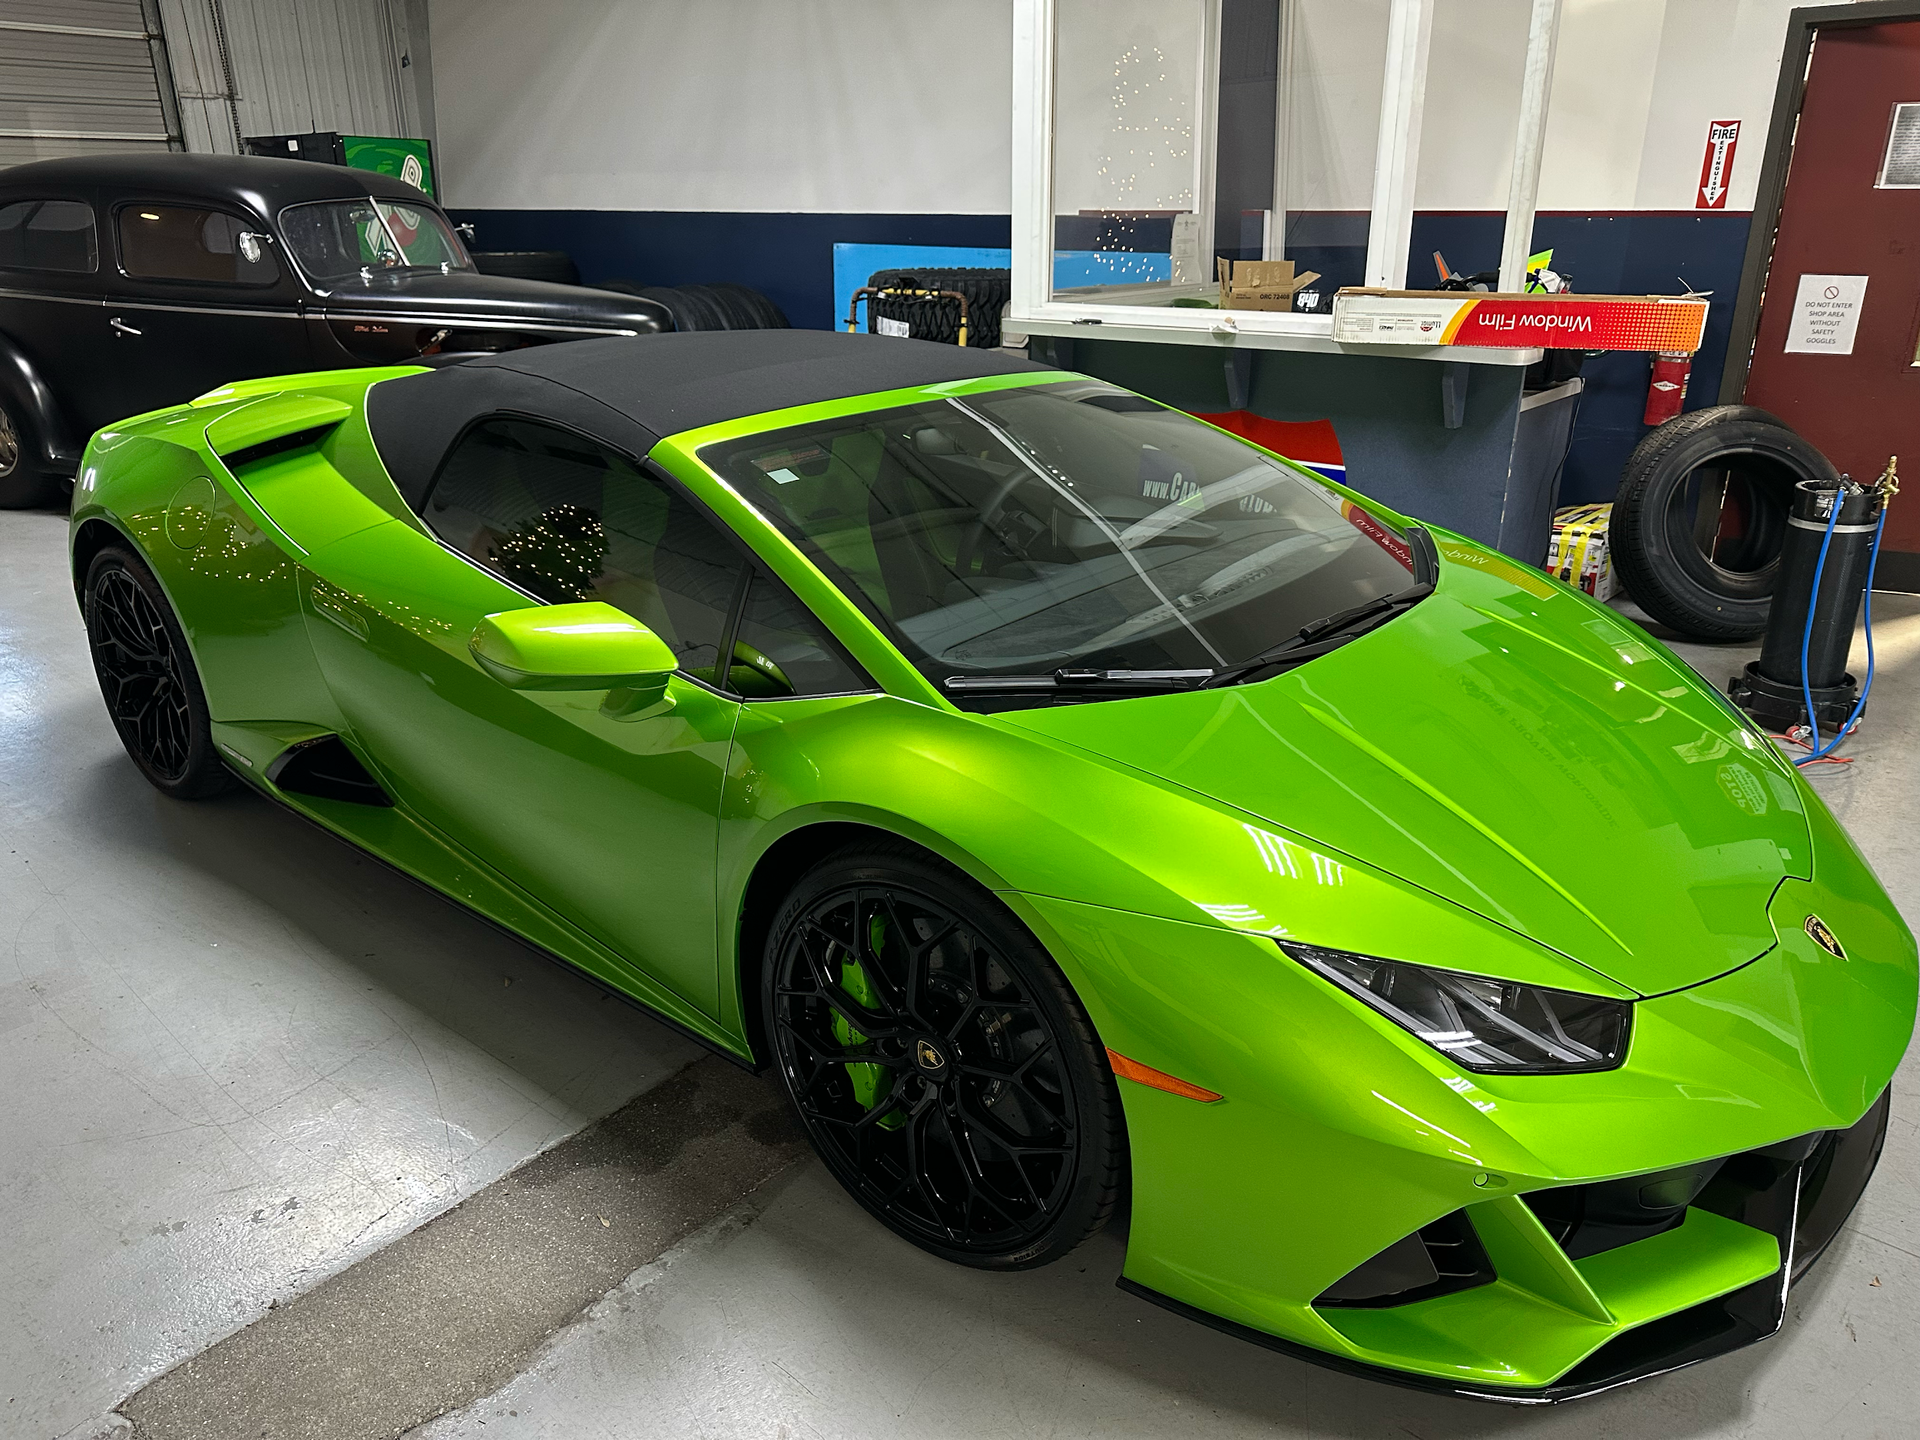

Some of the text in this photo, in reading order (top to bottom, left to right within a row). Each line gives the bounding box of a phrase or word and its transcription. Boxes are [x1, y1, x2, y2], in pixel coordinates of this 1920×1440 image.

[1711, 128, 1736, 140] FIRE
[1709, 140, 1724, 201] EXTINGUISHER
[1817, 301, 1831, 309] NOT
[1478, 313, 1592, 333] Window Film
[1809, 319, 1841, 327] WITHOUT
[1806, 337, 1836, 345] GOGGLES
